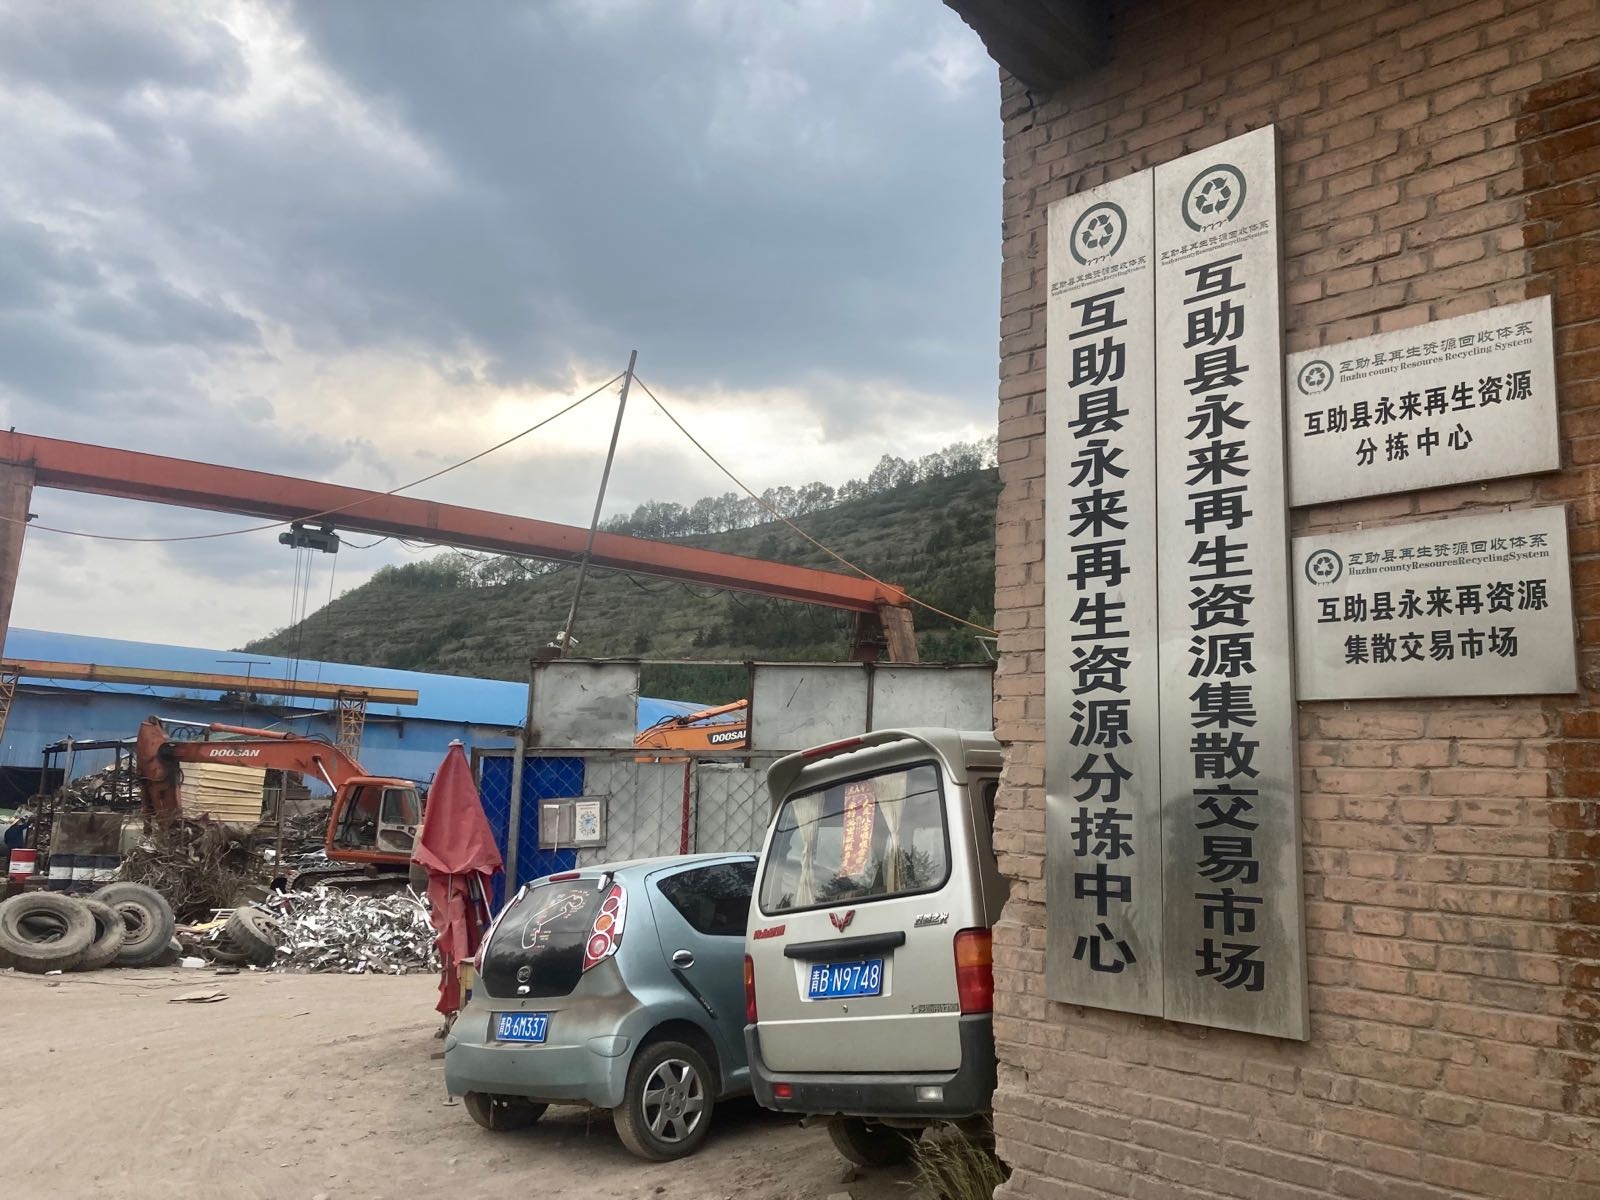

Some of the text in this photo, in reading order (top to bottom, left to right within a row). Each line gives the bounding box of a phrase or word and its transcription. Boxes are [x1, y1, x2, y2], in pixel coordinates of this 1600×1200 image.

[1339, 321, 1533, 373] 互助县再生资源回收体系
[1369, 366, 1399, 378] county
[1445, 345, 1492, 360] Recycling
[1495, 337, 1533, 352] System
[1304, 370, 1533, 437] 互助县永来再生资源
[1356, 423, 1473, 466] 分拣中心
[1348, 533, 1548, 566] 互助县再生资源回收体系
[1183, 254, 1265, 992] 互助县永来再生资源集散交易市场
[1317, 579, 1549, 624] 互助县永来再资源
[1067, 287, 1136, 974] 互助县永来再生资源分拣中心
[1344, 626, 1518, 664] 集散交易市场
[210, 749, 260, 757] DOOSAN
